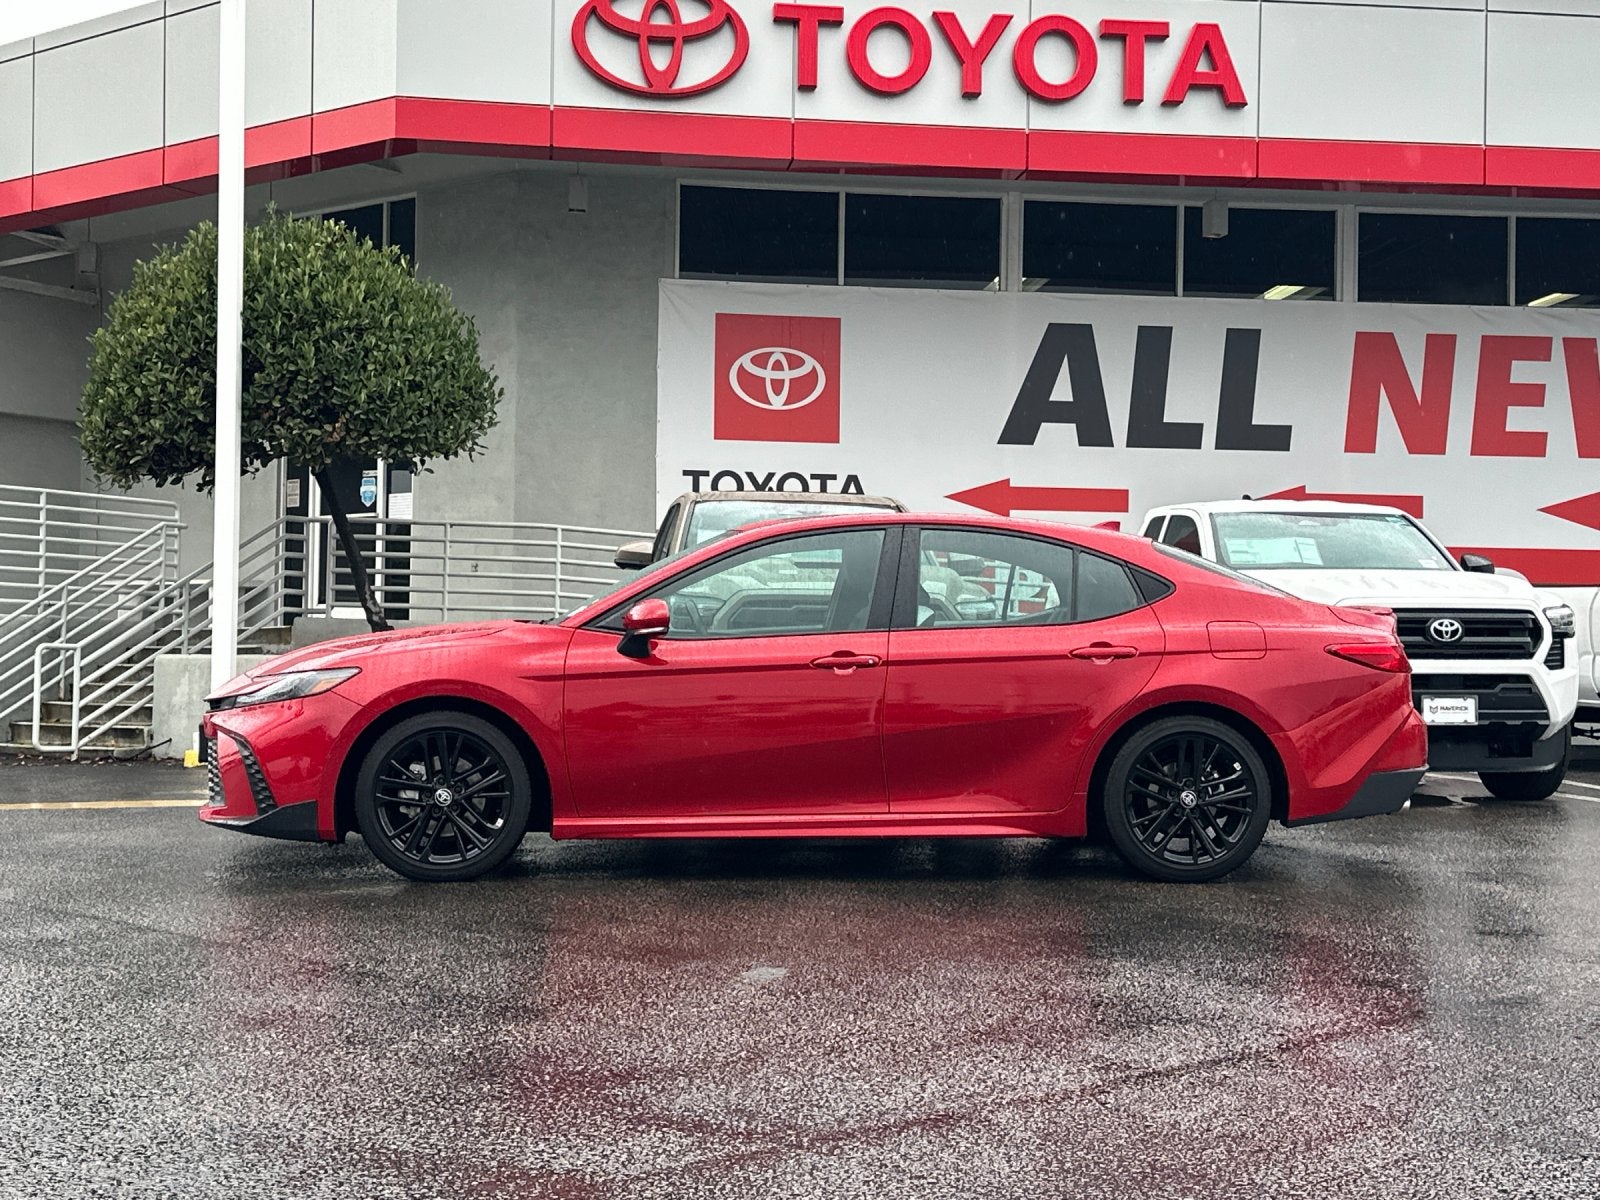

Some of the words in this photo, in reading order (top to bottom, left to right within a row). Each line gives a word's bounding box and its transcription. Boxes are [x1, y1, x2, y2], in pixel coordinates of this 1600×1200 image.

[773, 3, 1248, 108] TOYOTA
[997, 322, 1292, 452] ALL
[1344, 331, 1600, 459] NE
